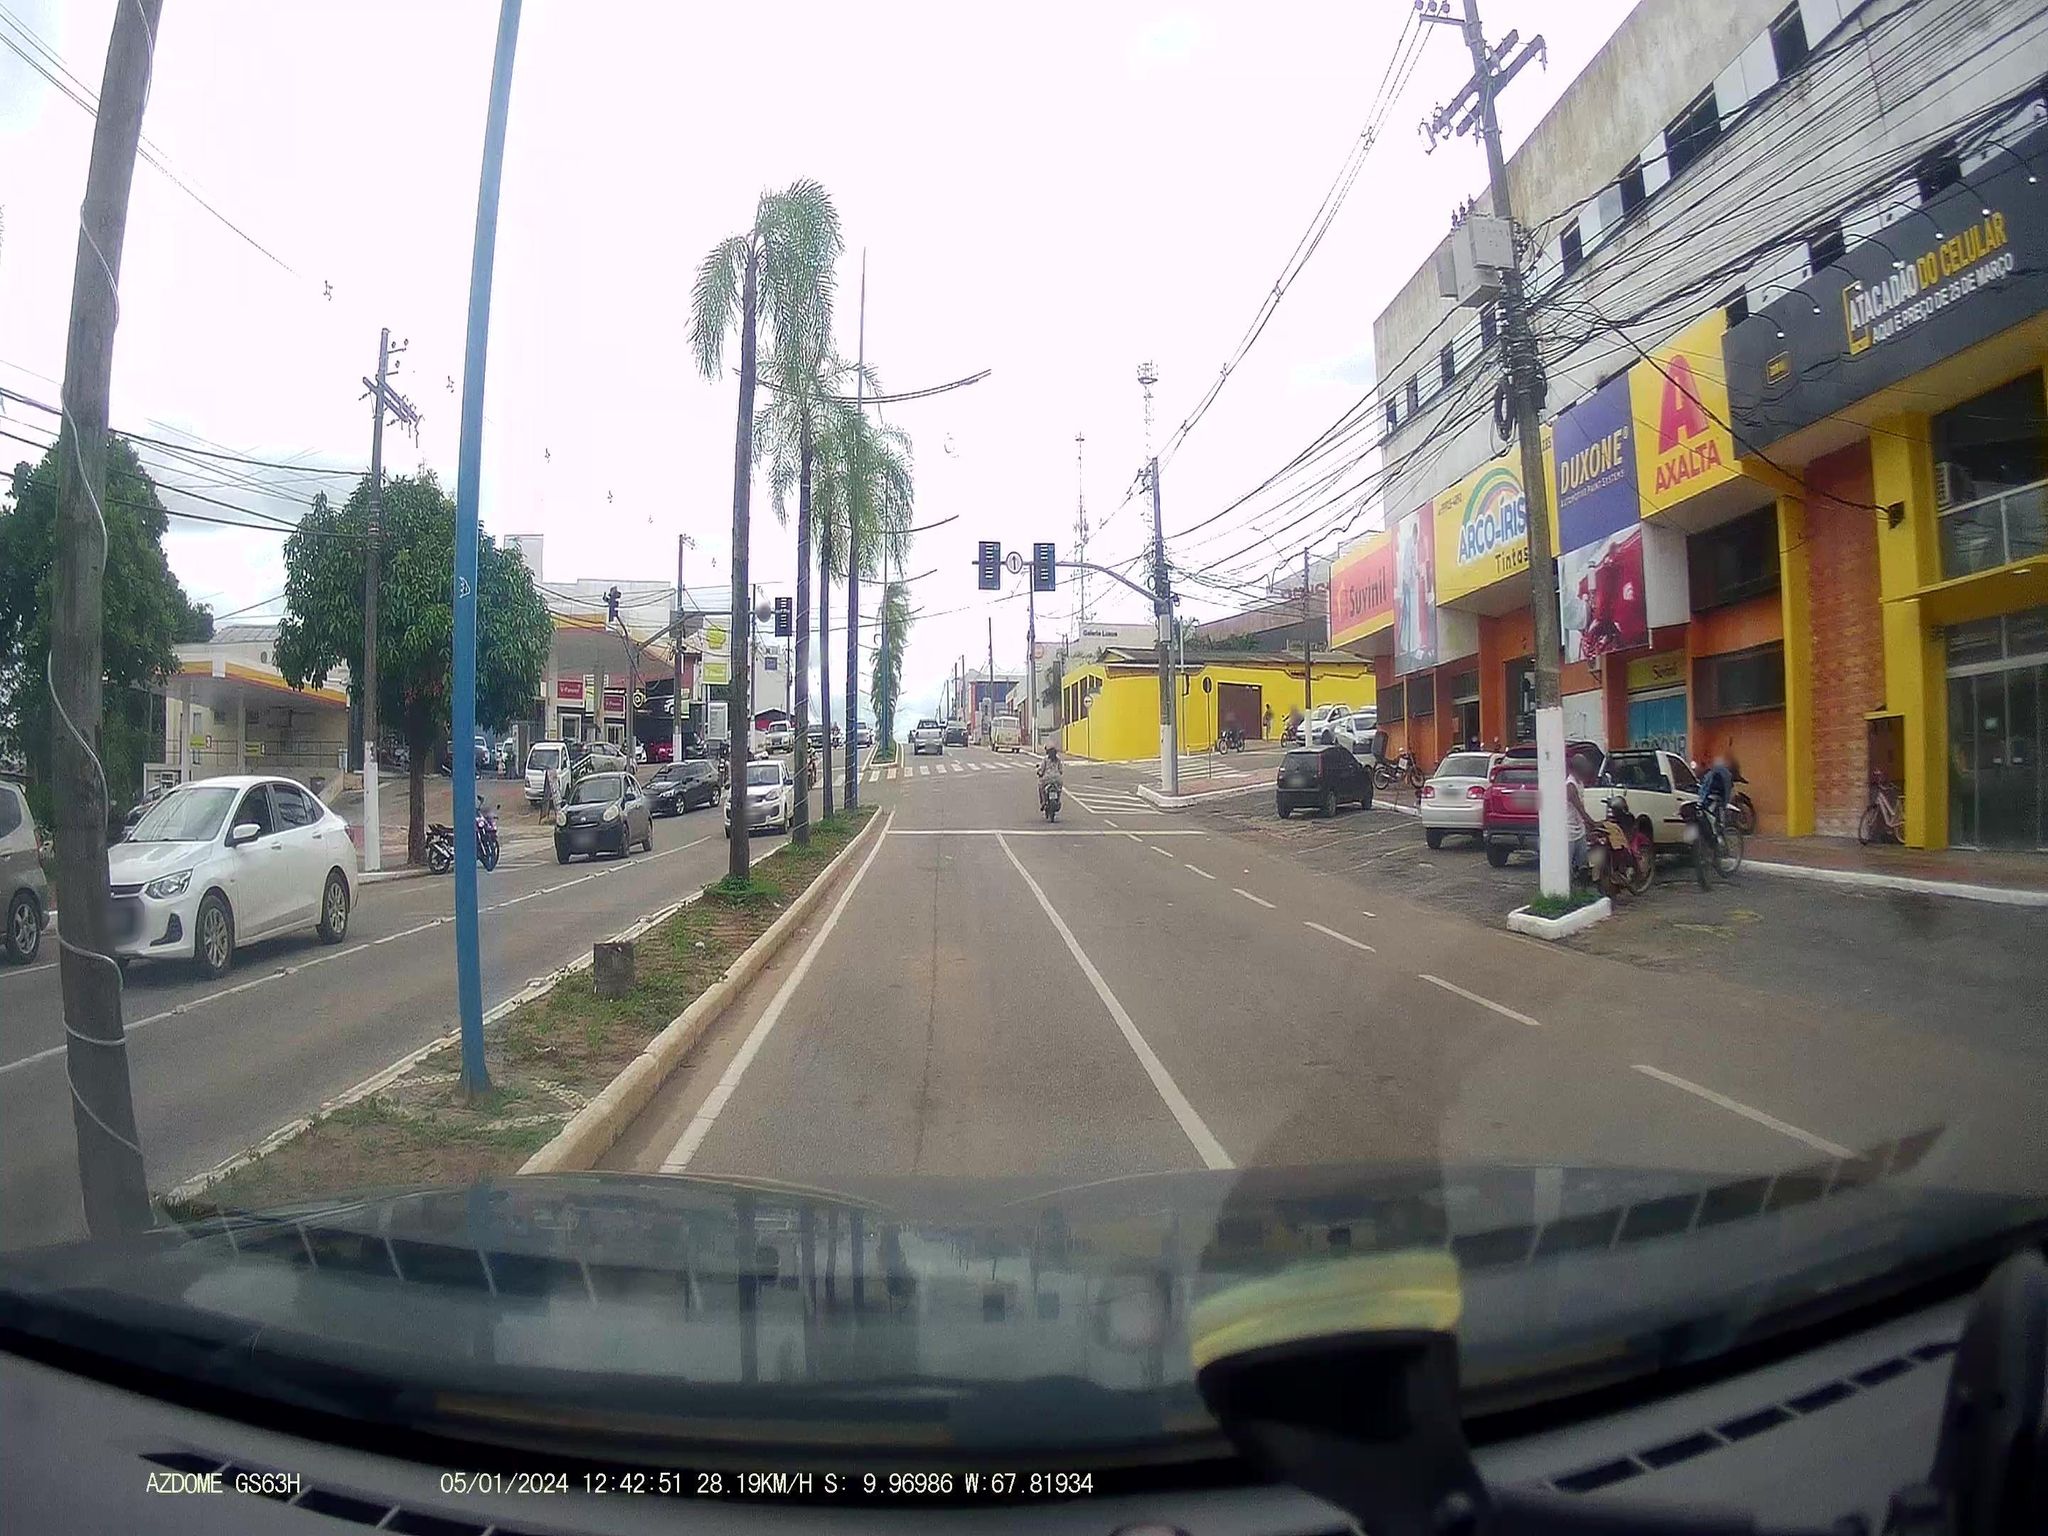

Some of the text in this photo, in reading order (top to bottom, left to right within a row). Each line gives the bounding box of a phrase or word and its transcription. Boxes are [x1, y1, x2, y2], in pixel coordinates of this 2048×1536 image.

[1849, 212, 2008, 331] ATACADÃO DO CELULAR
[1902, 296, 1934, 330] PREÇO
[1934, 288, 1950, 309] DE
[1961, 273, 1977, 295] DE
[1975, 252, 2015, 288] MARÇO
[1655, 439, 1722, 495] AXALTA
[1459, 495, 1527, 564] ARCO-ÍRIS
[1494, 546, 1529, 574] Tintas
[1349, 565, 1388, 618] Suvinil
